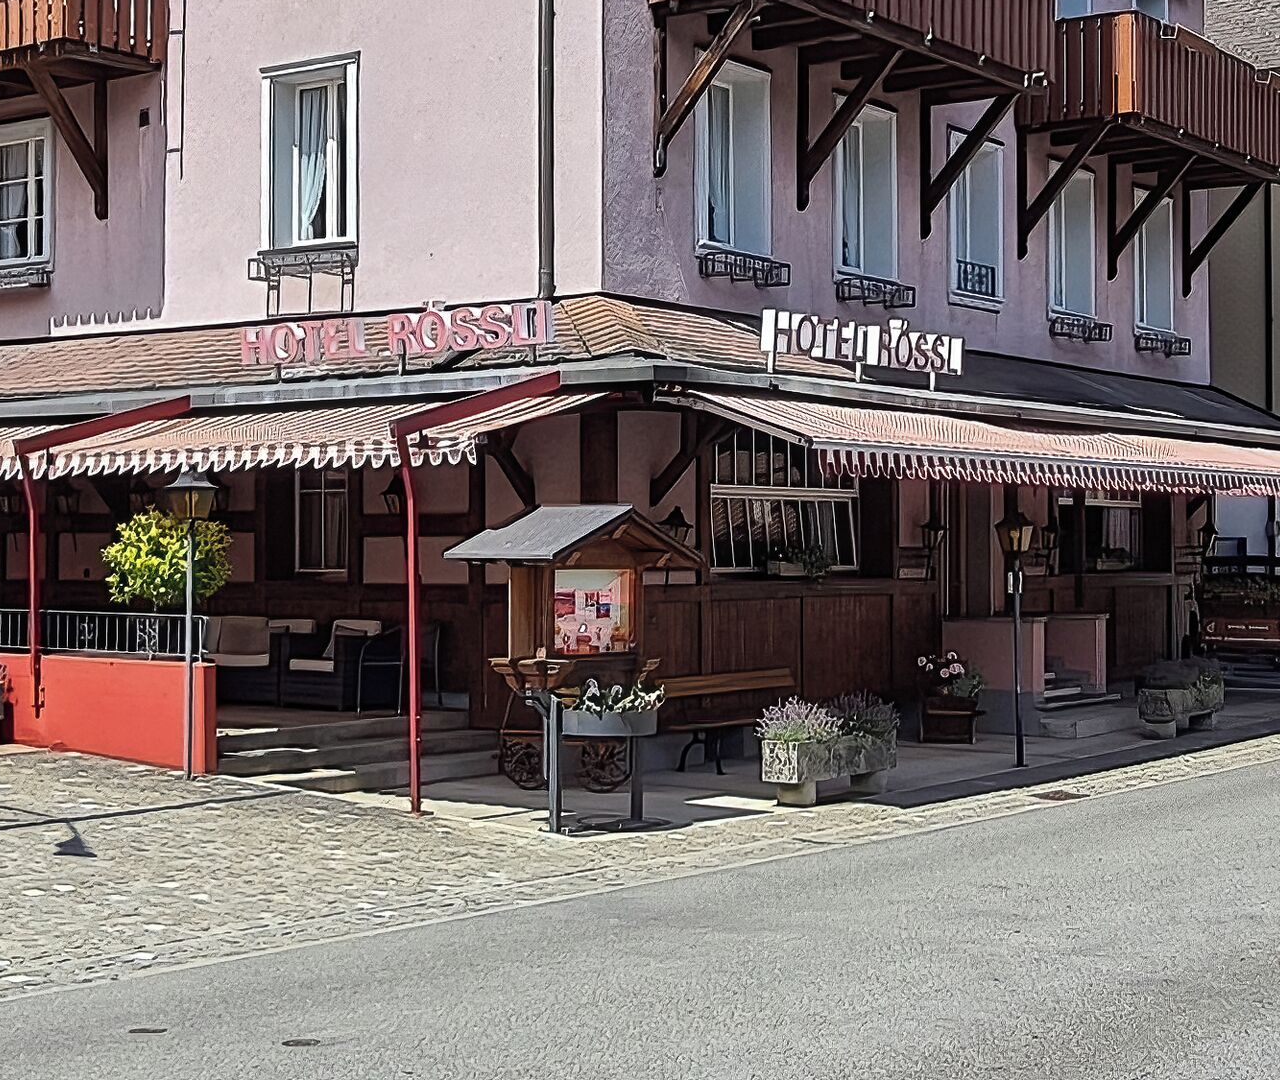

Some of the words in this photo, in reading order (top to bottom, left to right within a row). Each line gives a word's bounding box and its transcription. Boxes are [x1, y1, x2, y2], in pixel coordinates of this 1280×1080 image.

[241, 319, 366, 365] HOTEL
[388, 300, 552, 356] RÖSSLI
[762, 309, 866, 362] HOTEL
